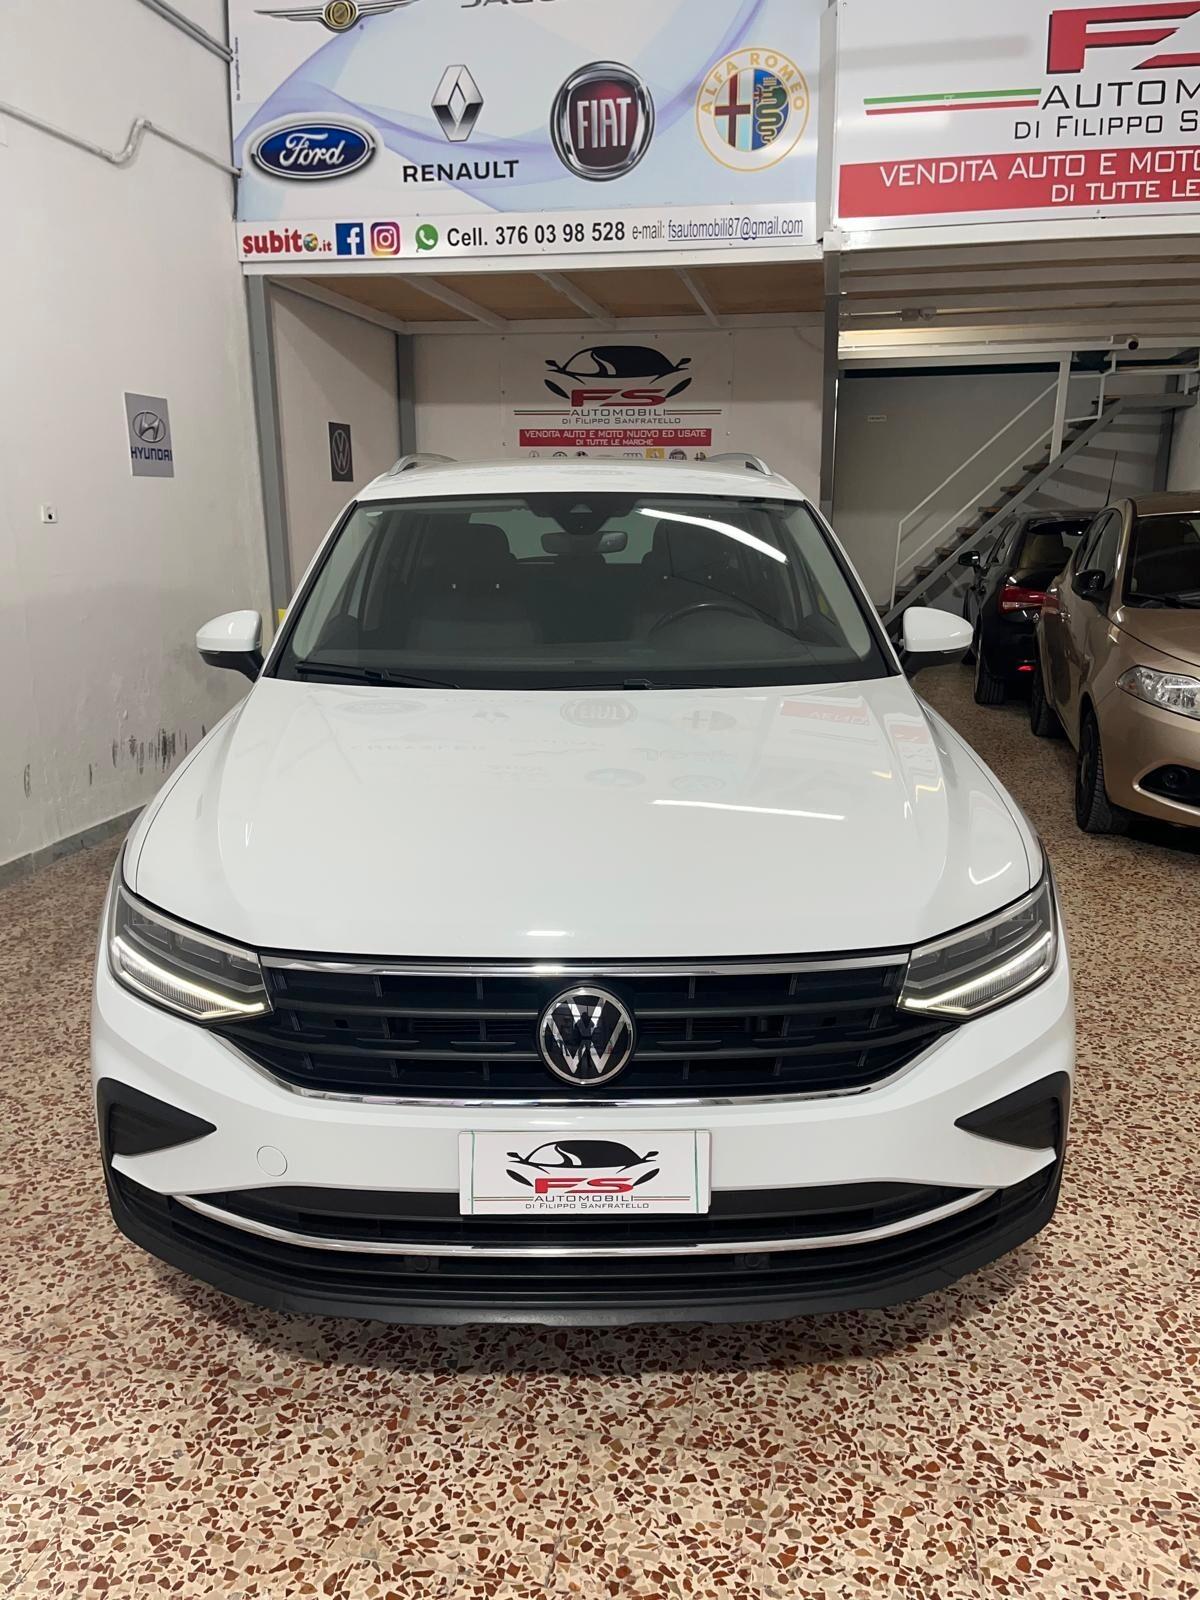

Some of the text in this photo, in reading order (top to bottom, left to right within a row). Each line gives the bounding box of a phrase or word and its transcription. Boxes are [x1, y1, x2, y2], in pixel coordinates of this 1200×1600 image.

[1046, 1, 1200, 74] F
[701, 53, 805, 114] ALFA ROMEO
[577, 97, 632, 150] FIAT
[1015, 120, 1040, 139] DI
[1056, 115, 1163, 138] FILIPPO
[279, 132, 345, 167] Ford
[402, 160, 520, 183] RENAULT
[880, 158, 998, 187] VENDITA
[1008, 153, 1085, 180] AUTO
[1100, 152, 1117, 175] E
[1051, 184, 1075, 202] DI
[1085, 180, 1160, 200] TUTTE
[447, 216, 804, 246] Cell. 376 03 98 528 e-mail: fsautomobili87@gmail.com
[571, 389, 667, 407] FS
[561, 417, 571, 425] DI
[575, 417, 611, 425] FILIPPO
[571, 408, 666, 416] AUTOMOBILI
[678, 430, 706, 438] USATE
[130, 446, 172, 462] HYUNDAI
[535, 1178, 634, 1194] FS
